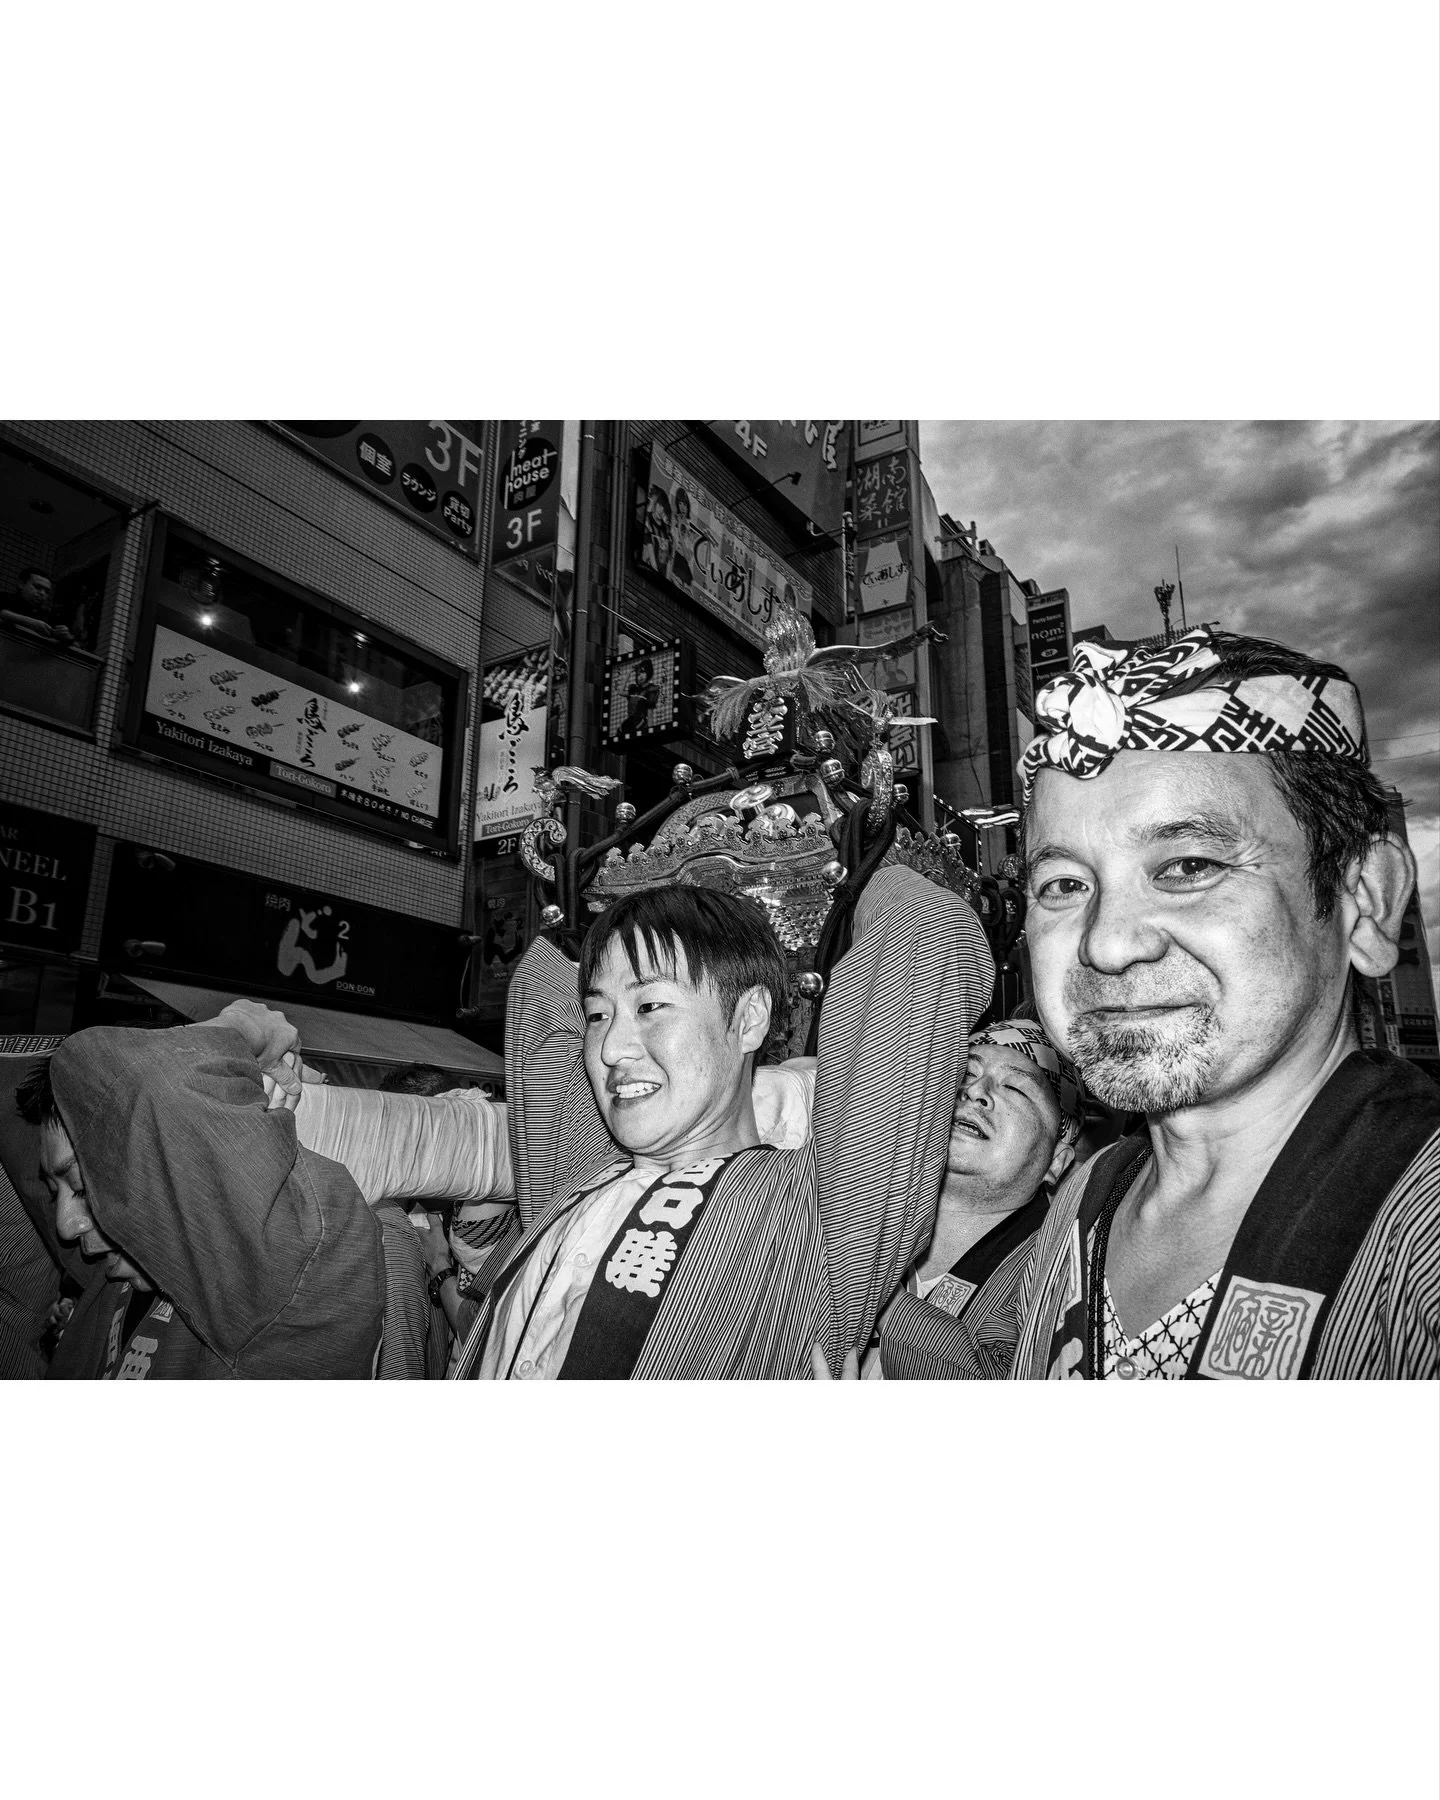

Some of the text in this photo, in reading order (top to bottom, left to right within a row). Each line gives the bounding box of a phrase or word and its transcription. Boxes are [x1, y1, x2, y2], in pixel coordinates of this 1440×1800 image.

[424, 420, 485, 487] 3F
[735, 420, 767, 457] 4F
[359, 441, 393, 477] 個室
[510, 448, 557, 482] meat
[401, 472, 437, 502] ラウンジ
[504, 467, 550, 510] house
[443, 505, 474, 536] Party
[505, 509, 541, 549] 3F
[156, 720, 254, 766] Yakitori Izakaya
[276, 765, 332, 793] Tori-Gokoro
[476, 808, 508, 823] Yakitori
[497, 837, 517, 855] 2F
[4, 885, 58, 931] B1
[264, 892, 291, 912] 焼肉
[337, 920, 350, 940] 2
